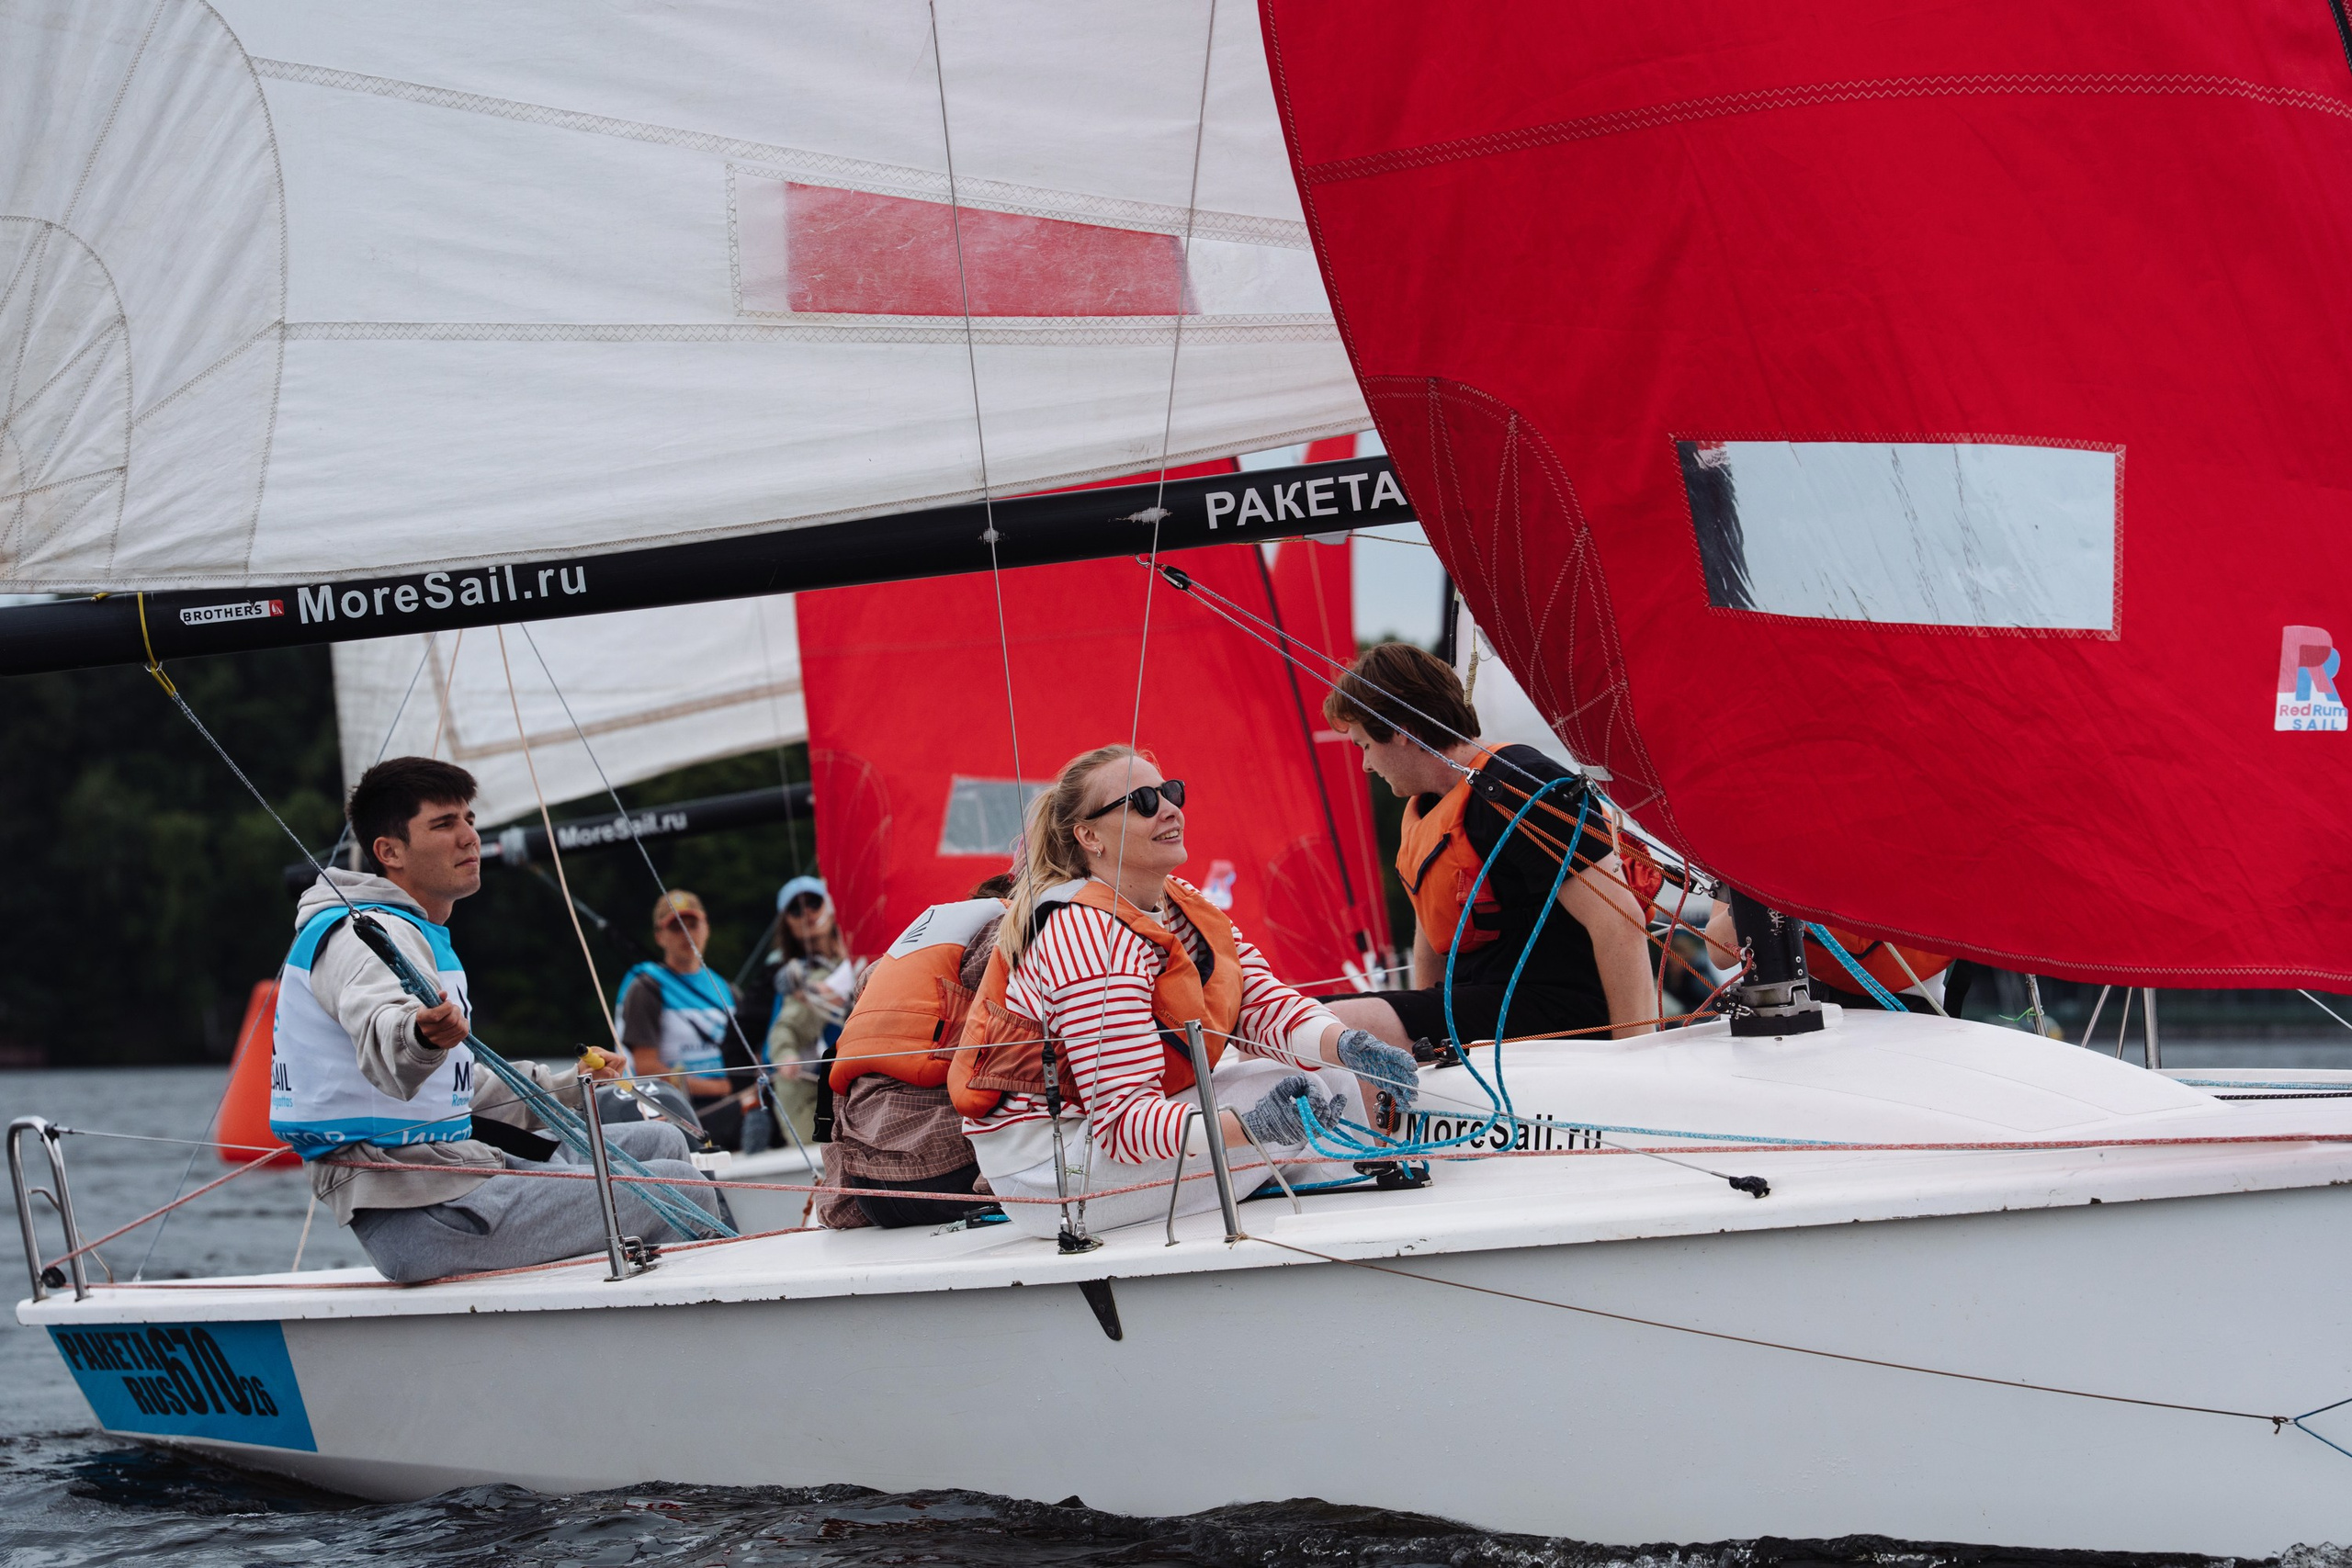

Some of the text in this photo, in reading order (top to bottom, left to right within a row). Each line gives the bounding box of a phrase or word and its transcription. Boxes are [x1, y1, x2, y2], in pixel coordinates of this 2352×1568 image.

[1205, 470, 1408, 530] РАКЕТА
[298, 564, 587, 625] MoreSail.ru
[183, 603, 263, 623] BROTHERS
[2292, 719, 2338, 730] SAIL
[557, 811, 688, 849] MoreSail.ru
[1165, 1012, 1185, 1029] TRIBO
[1407, 1114, 1601, 1150] MoreSail.ru
